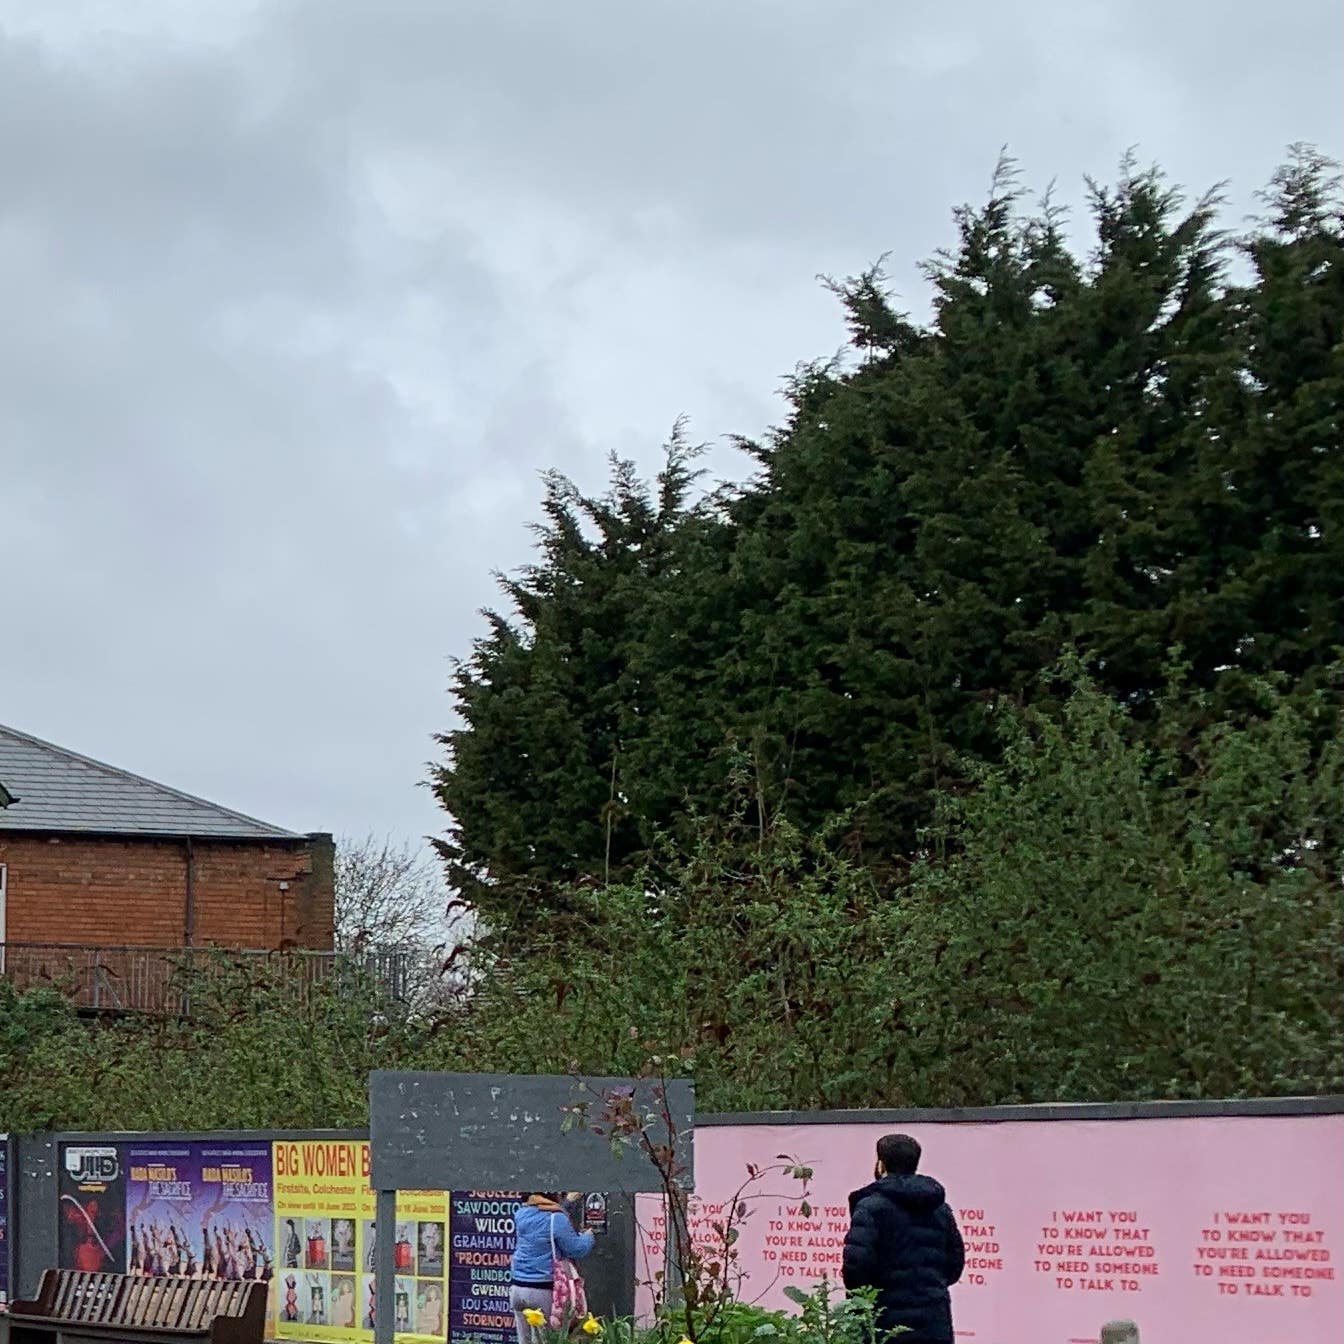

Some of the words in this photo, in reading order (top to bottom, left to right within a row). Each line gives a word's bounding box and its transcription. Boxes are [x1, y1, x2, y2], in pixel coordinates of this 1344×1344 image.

[276, 1145, 299, 1176] BIG
[303, 1145, 356, 1176] WOMEN
[313, 1184, 356, 1195] Colchester
[702, 1205, 723, 1214] YOU
[786, 1207, 818, 1217] WAT
[825, 1206, 846, 1217] YOU
[959, 1209, 984, 1220] YOU
[653, 1217, 665, 1226] TO
[1062, 1211, 1103, 1223] WANT
[1109, 1211, 1137, 1223] YOU
[1224, 1212, 1272, 1225] WANT
[1279, 1213, 1311, 1225] YOU
[474, 1218, 515, 1233] WILCO
[769, 1220, 783, 1230] TO
[788, 1221, 823, 1232] KNOW
[828, 1222, 850, 1232] THA
[963, 1225, 995, 1237] THAT
[1042, 1227, 1059, 1238] TO
[1064, 1228, 1107, 1239] KNOW
[1114, 1228, 1150, 1240] THAT
[1202, 1229, 1221, 1242] TO
[1227, 1230, 1277, 1243] KNOW
[1283, 1230, 1325, 1243] THAT
[453, 1236, 506, 1249] GRAHAM
[766, 1235, 802, 1247] YOU'RE
[807, 1236, 845, 1247] ALLOW
[963, 1241, 1000, 1253] OWED
[647, 1245, 659, 1255] TO
[763, 1250, 777, 1260] TO
[781, 1251, 807, 1262] NEED
[812, 1252, 841, 1262] SOME
[1038, 1244, 1083, 1256] YOU'RE
[1089, 1245, 1155, 1258] ALLOWED
[1197, 1247, 1248, 1260] YOU'RE
[1255, 1248, 1331, 1262] ALLOWED
[458, 1253, 512, 1266] PROCLAIM
[963, 1258, 1003, 1270] MEONE
[780, 1265, 794, 1276] TO
[1034, 1260, 1051, 1272] TO
[1057, 1261, 1089, 1273] NEED
[1095, 1262, 1159, 1275] SOMEONE
[1193, 1264, 1213, 1276] TO
[1219, 1265, 1256, 1278] NEED
[1263, 1266, 1335, 1280] SOMEONE
[470, 1269, 512, 1282] BLINDBO
[1056, 1277, 1073, 1289] TO
[1080, 1278, 1114, 1290] TALK
[1120, 1279, 1143, 1292] TO.
[1218, 1282, 1238, 1295] TO
[1244, 1283, 1284, 1297] TALK
[462, 1299, 480, 1310] LOU
[482, 1300, 512, 1311] SAND
[463, 1313, 512, 1327] STORNOW
